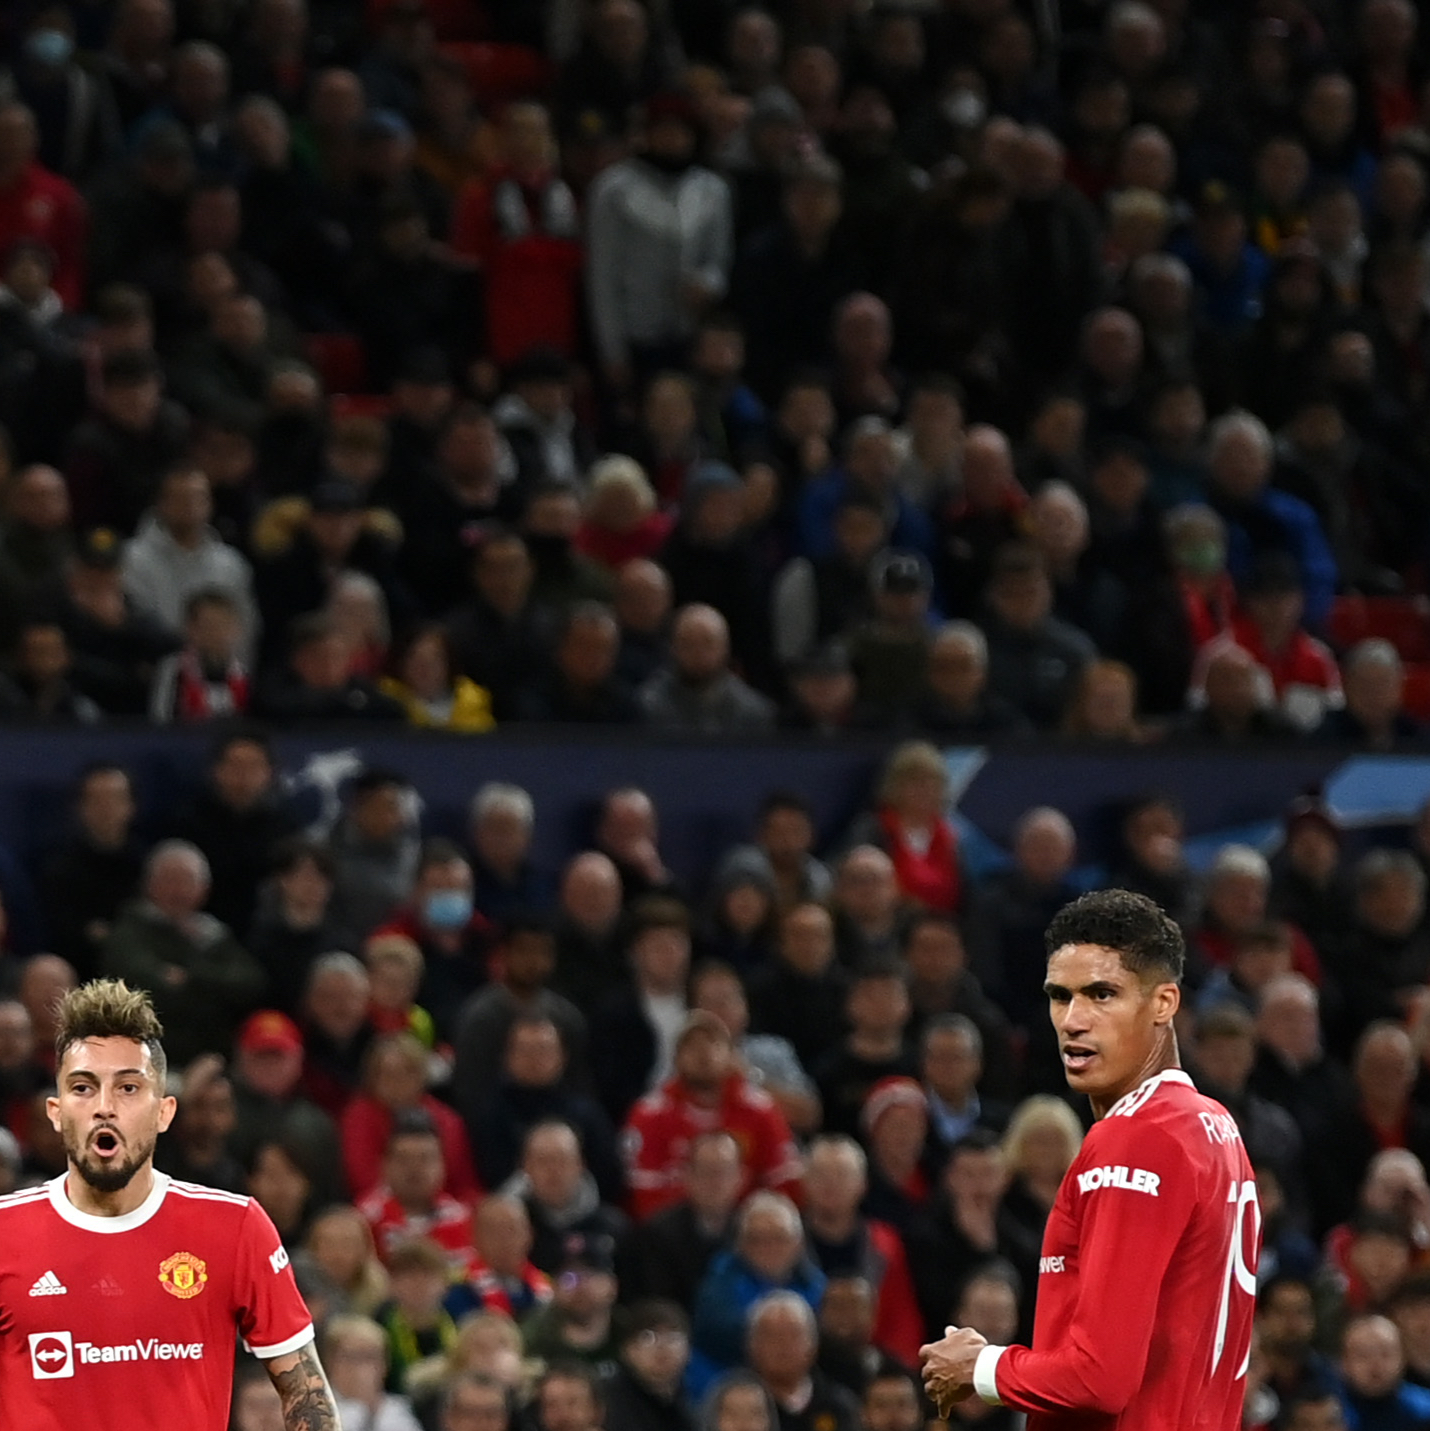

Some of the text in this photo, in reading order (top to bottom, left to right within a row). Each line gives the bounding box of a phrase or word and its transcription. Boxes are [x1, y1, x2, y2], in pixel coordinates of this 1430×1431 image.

[1077, 1166, 1161, 1196] KOHLER
[29, 1286, 67, 1297] adidas
[1211, 1179, 1262, 1381] 19
